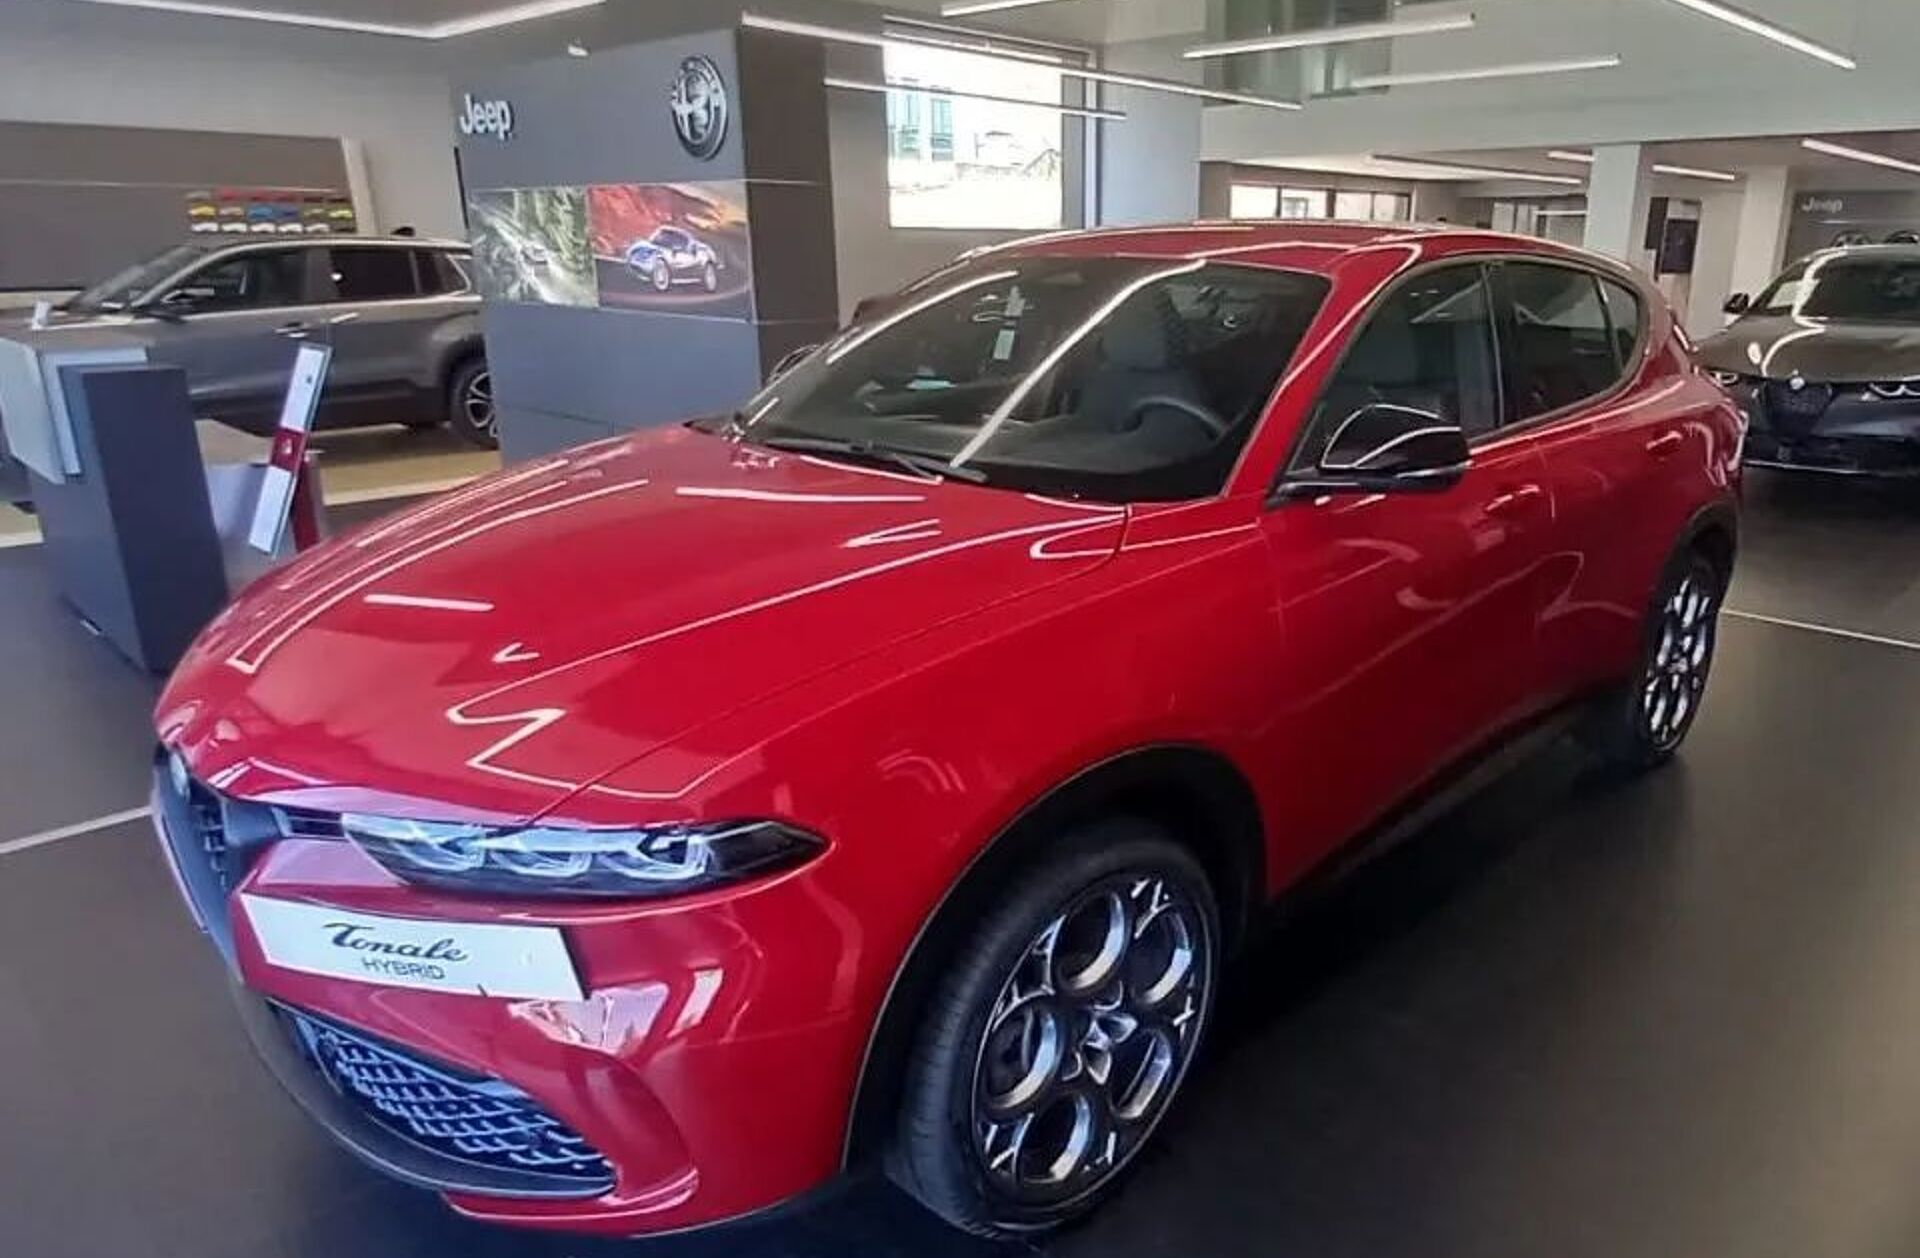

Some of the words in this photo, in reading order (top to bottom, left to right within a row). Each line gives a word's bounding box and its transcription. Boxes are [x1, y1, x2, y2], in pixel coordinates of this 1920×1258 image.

[460, 93, 512, 140] Jeep
[323, 922, 468, 962] Tonale
[361, 957, 446, 980] HYBRID
